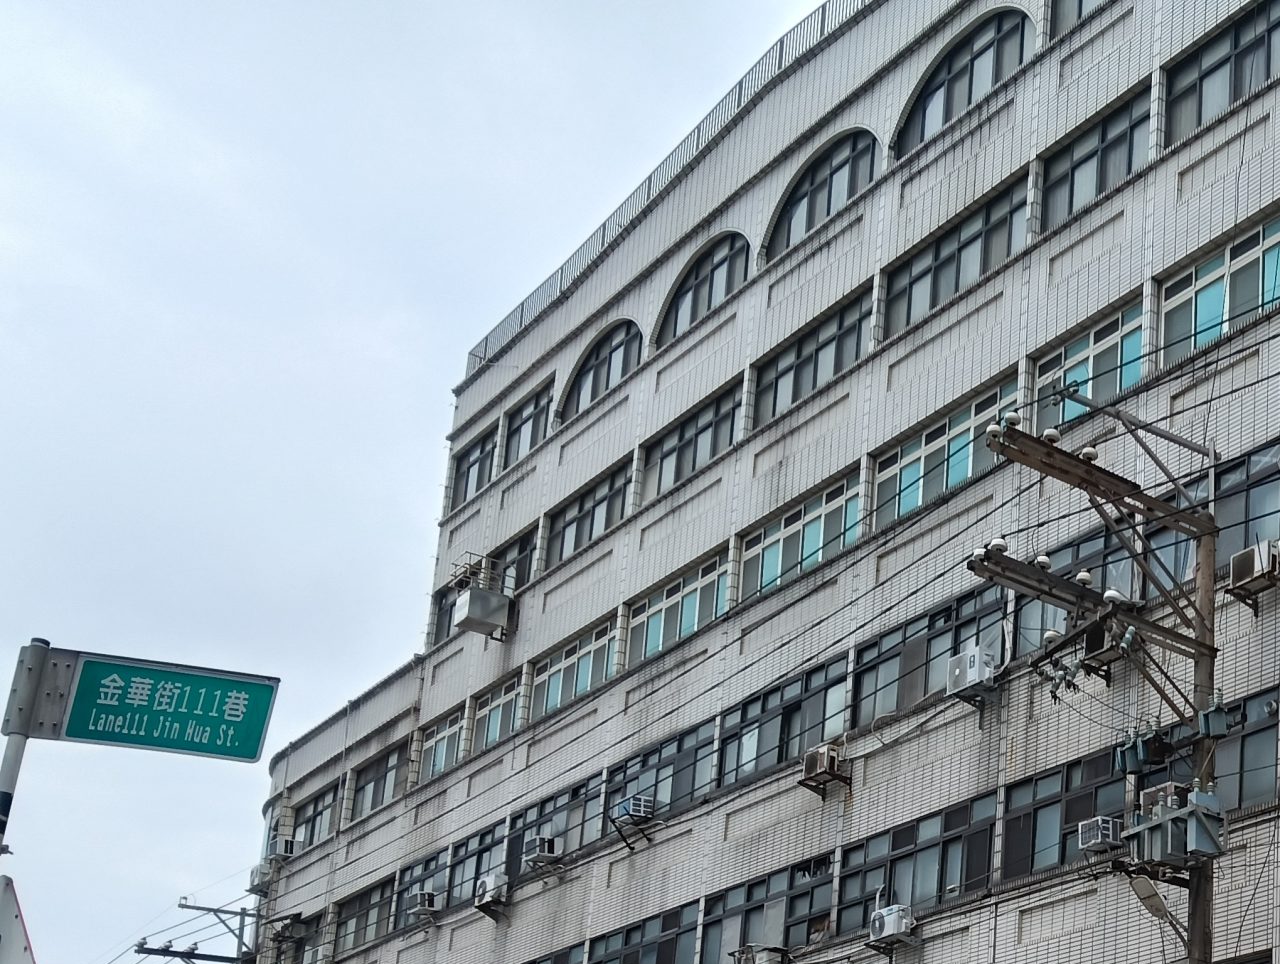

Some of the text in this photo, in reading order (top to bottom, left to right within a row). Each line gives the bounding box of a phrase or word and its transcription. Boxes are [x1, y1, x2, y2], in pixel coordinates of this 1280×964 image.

[96, 673, 249, 722] 金華街111巷
[153, 715, 179, 739] Jin
[184, 719, 211, 745] Hua
[216, 723, 239, 748] St.
